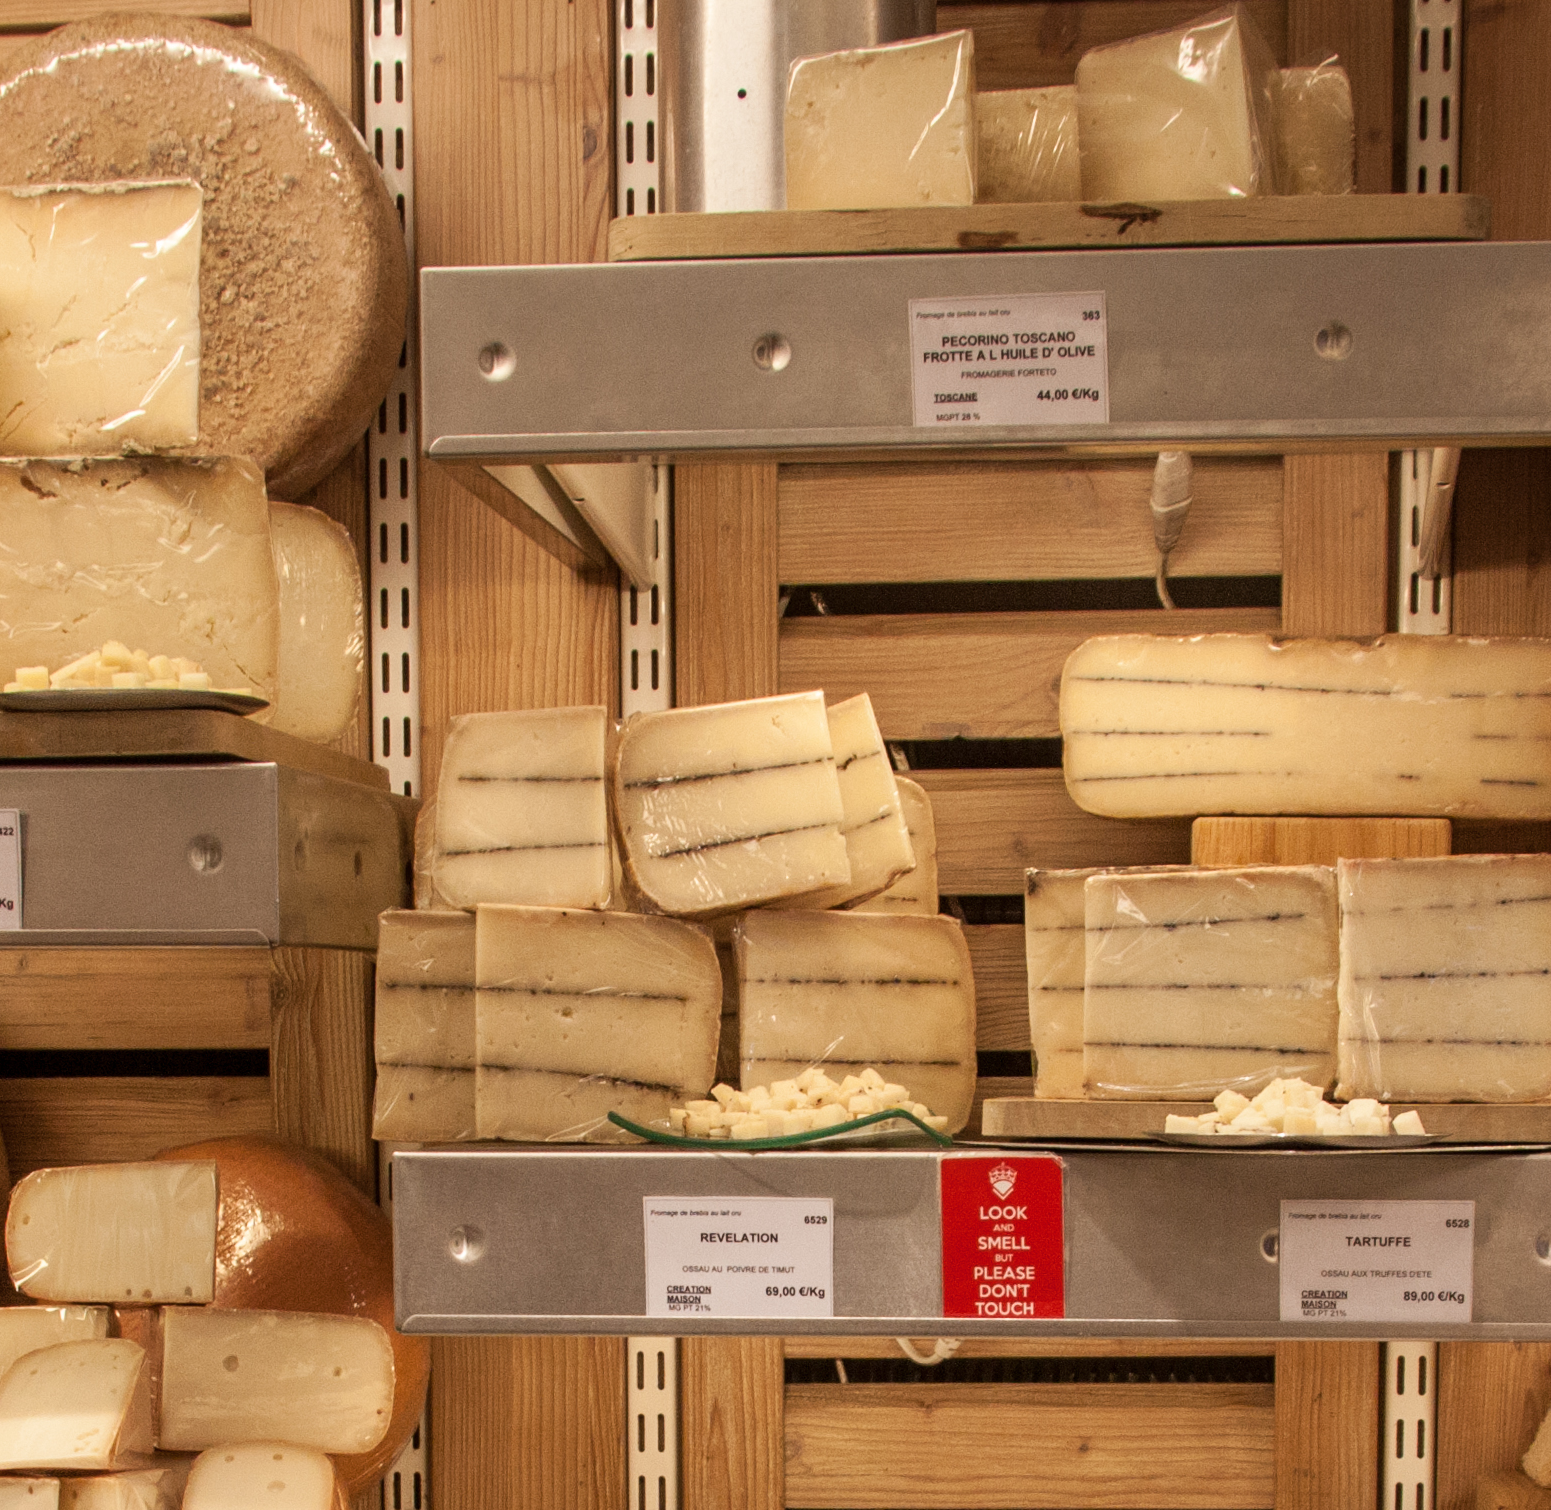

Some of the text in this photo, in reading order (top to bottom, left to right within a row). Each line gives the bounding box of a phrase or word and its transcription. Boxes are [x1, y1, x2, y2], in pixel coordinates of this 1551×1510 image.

[1082, 311, 1100, 320] 363
[942, 332, 1075, 347] PECORINO TOSCANO
[924, 346, 1095, 362] FROTTE A L HUILE D' OLIVE
[934, 393, 978, 402] TOSCANE
[1037, 389, 1099, 402] 44,00 €/Kg
[980, 1206, 1027, 1220] LOOK
[804, 1216, 827, 1224] 6529
[993, 1224, 1014, 1232] AND
[701, 1233, 778, 1242] REVELATION
[1346, 1237, 1411, 1247] TARTUFFE
[978, 1237, 1030, 1250] SMELL
[995, 1254, 1013, 1262] BUT
[974, 1267, 1035, 1280] PLEASE
[766, 1287, 825, 1298] 69,00 €/Kg
[980, 1284, 1030, 1298] DON'T
[1404, 1292, 1464, 1303] 89,00 €/Kg
[975, 1302, 1034, 1315] TOUCH
